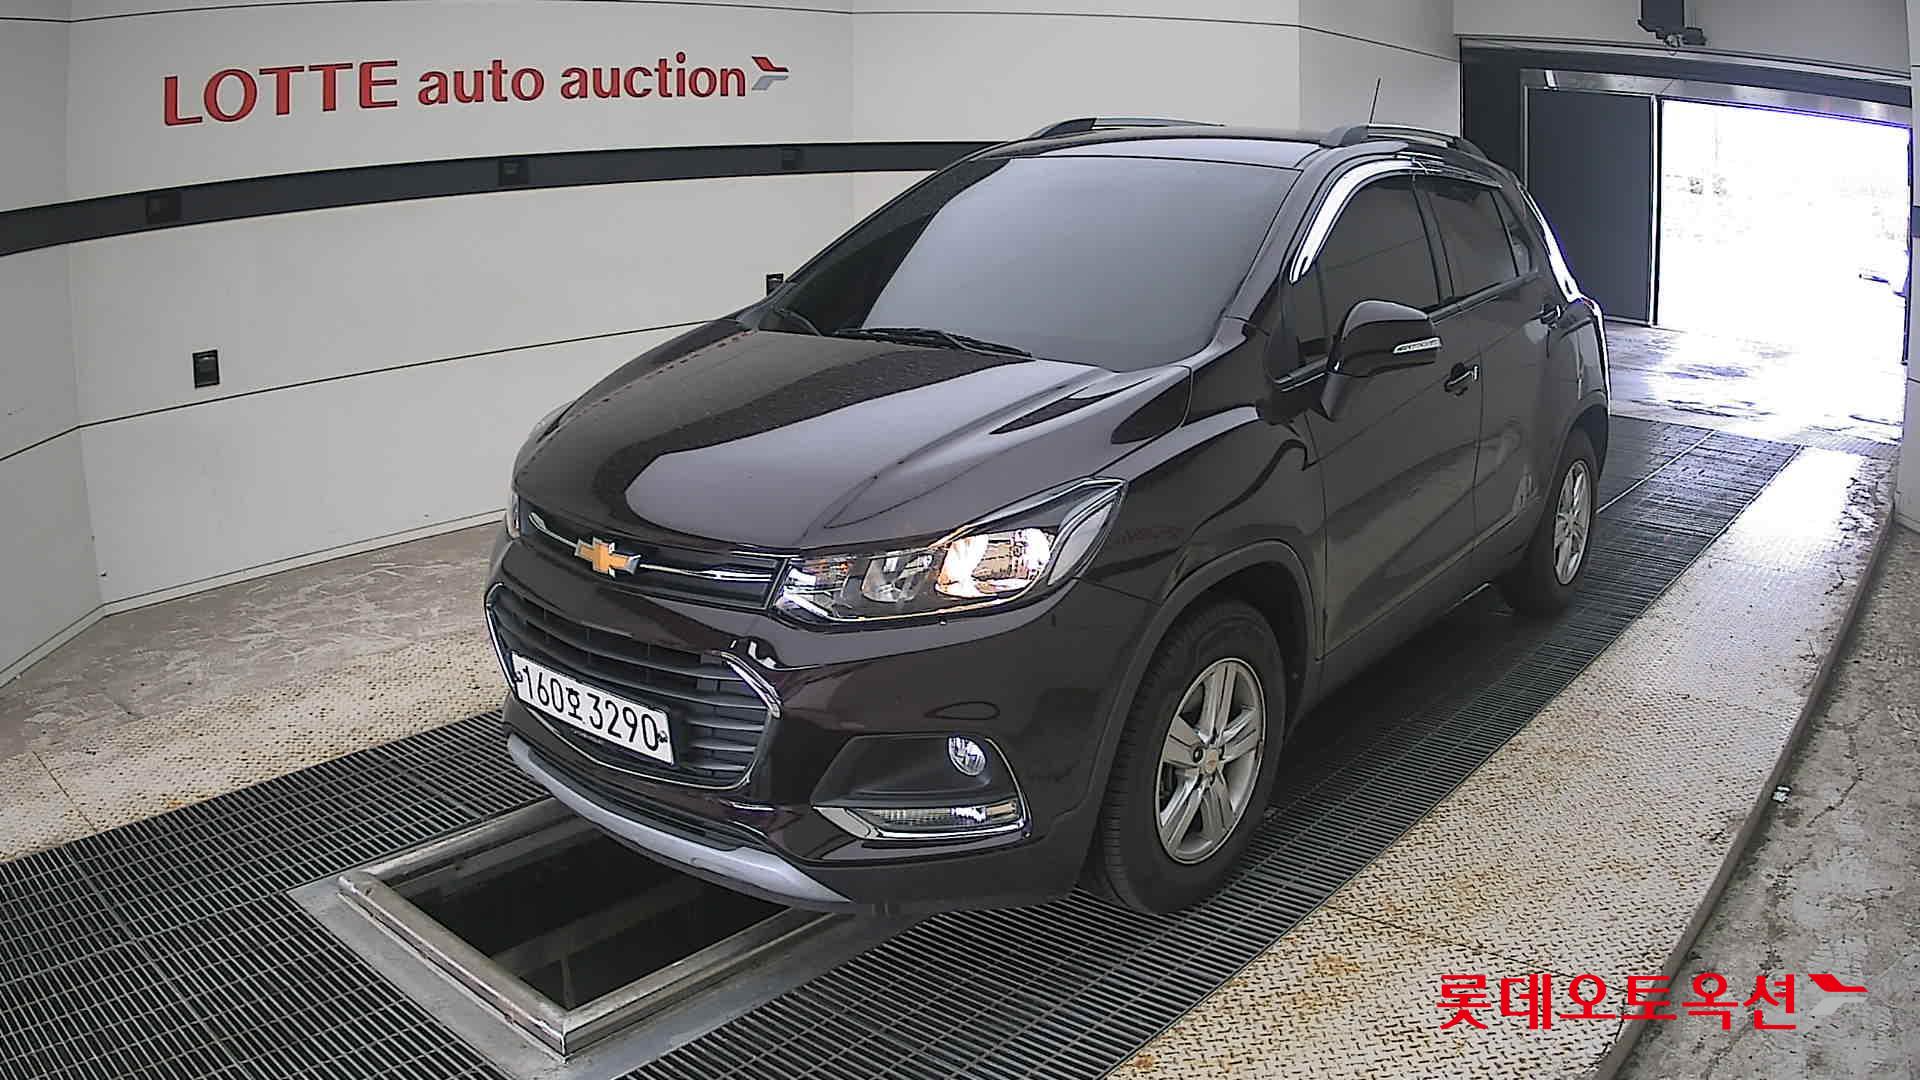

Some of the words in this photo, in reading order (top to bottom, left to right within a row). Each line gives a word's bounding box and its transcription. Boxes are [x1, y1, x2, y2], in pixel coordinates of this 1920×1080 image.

[164, 60, 398, 125] LOTTE
[418, 60, 544, 105] auto
[561, 52, 746, 99] auction
